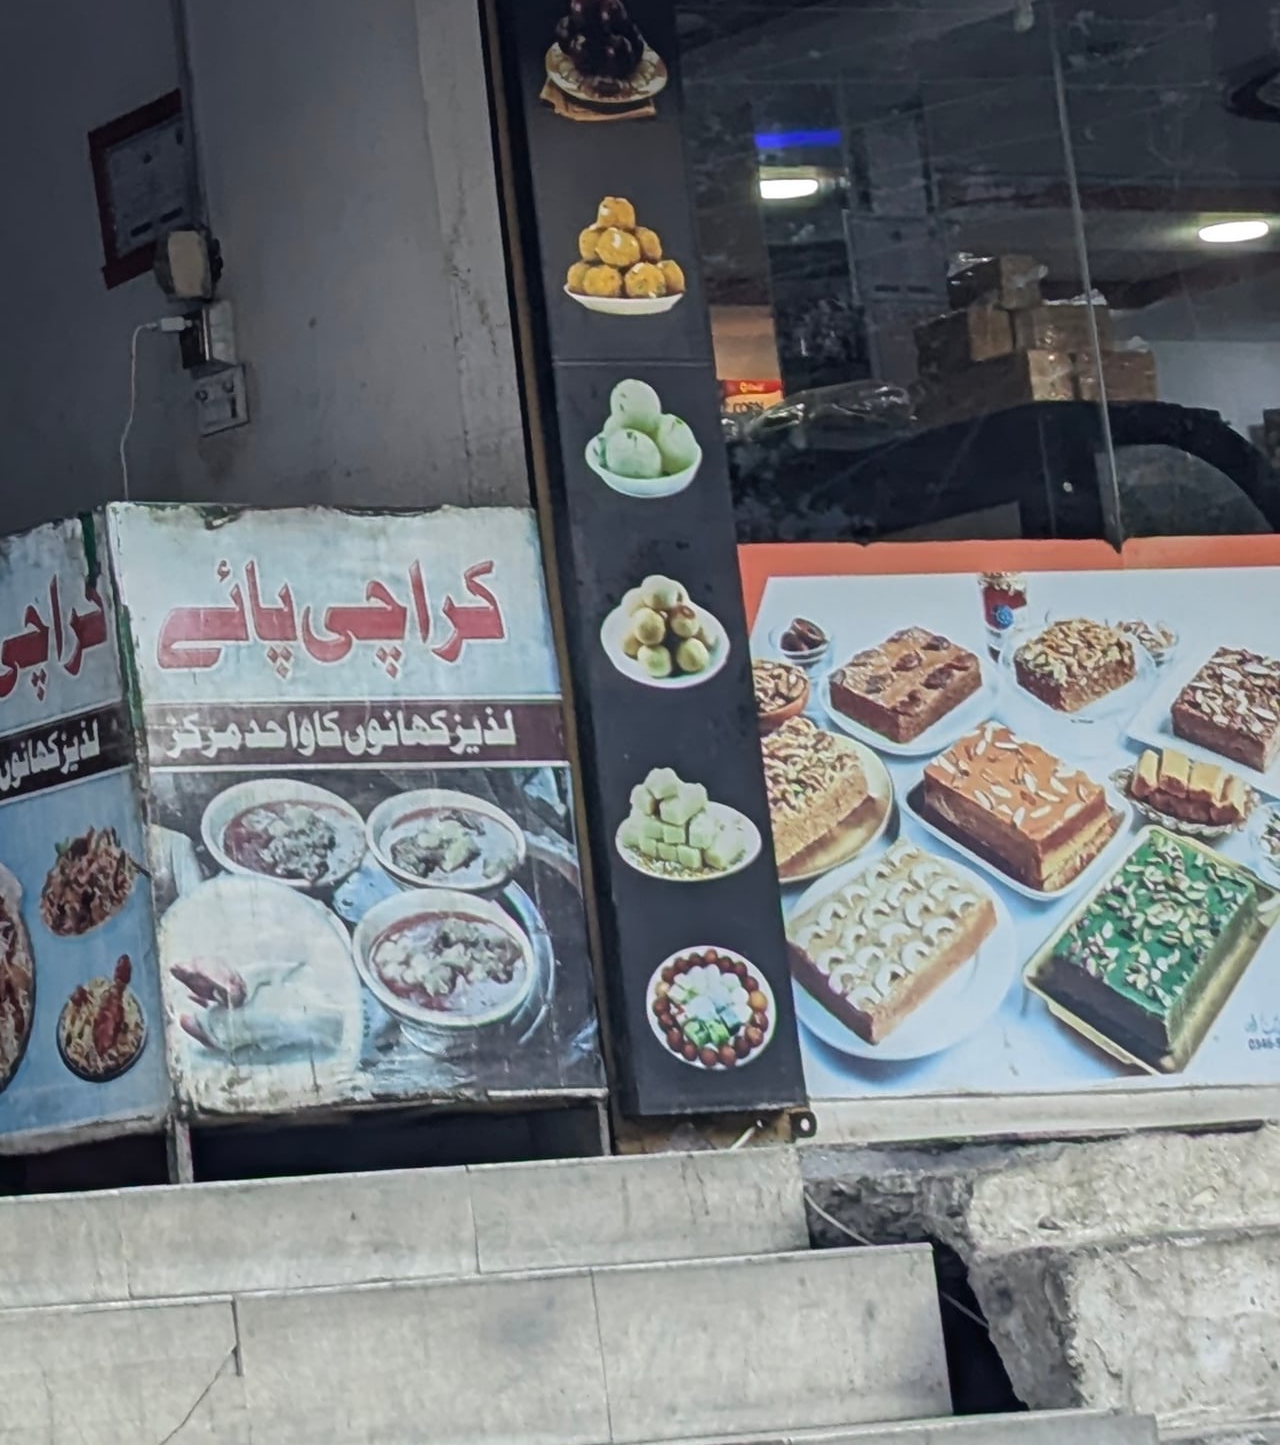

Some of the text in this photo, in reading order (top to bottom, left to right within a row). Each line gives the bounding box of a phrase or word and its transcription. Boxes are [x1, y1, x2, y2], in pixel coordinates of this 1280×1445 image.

[157, 559, 505, 679] کراچی پائے
[165, 711, 242, 758] مرکز
[344, 709, 450, 755] کھانوں
